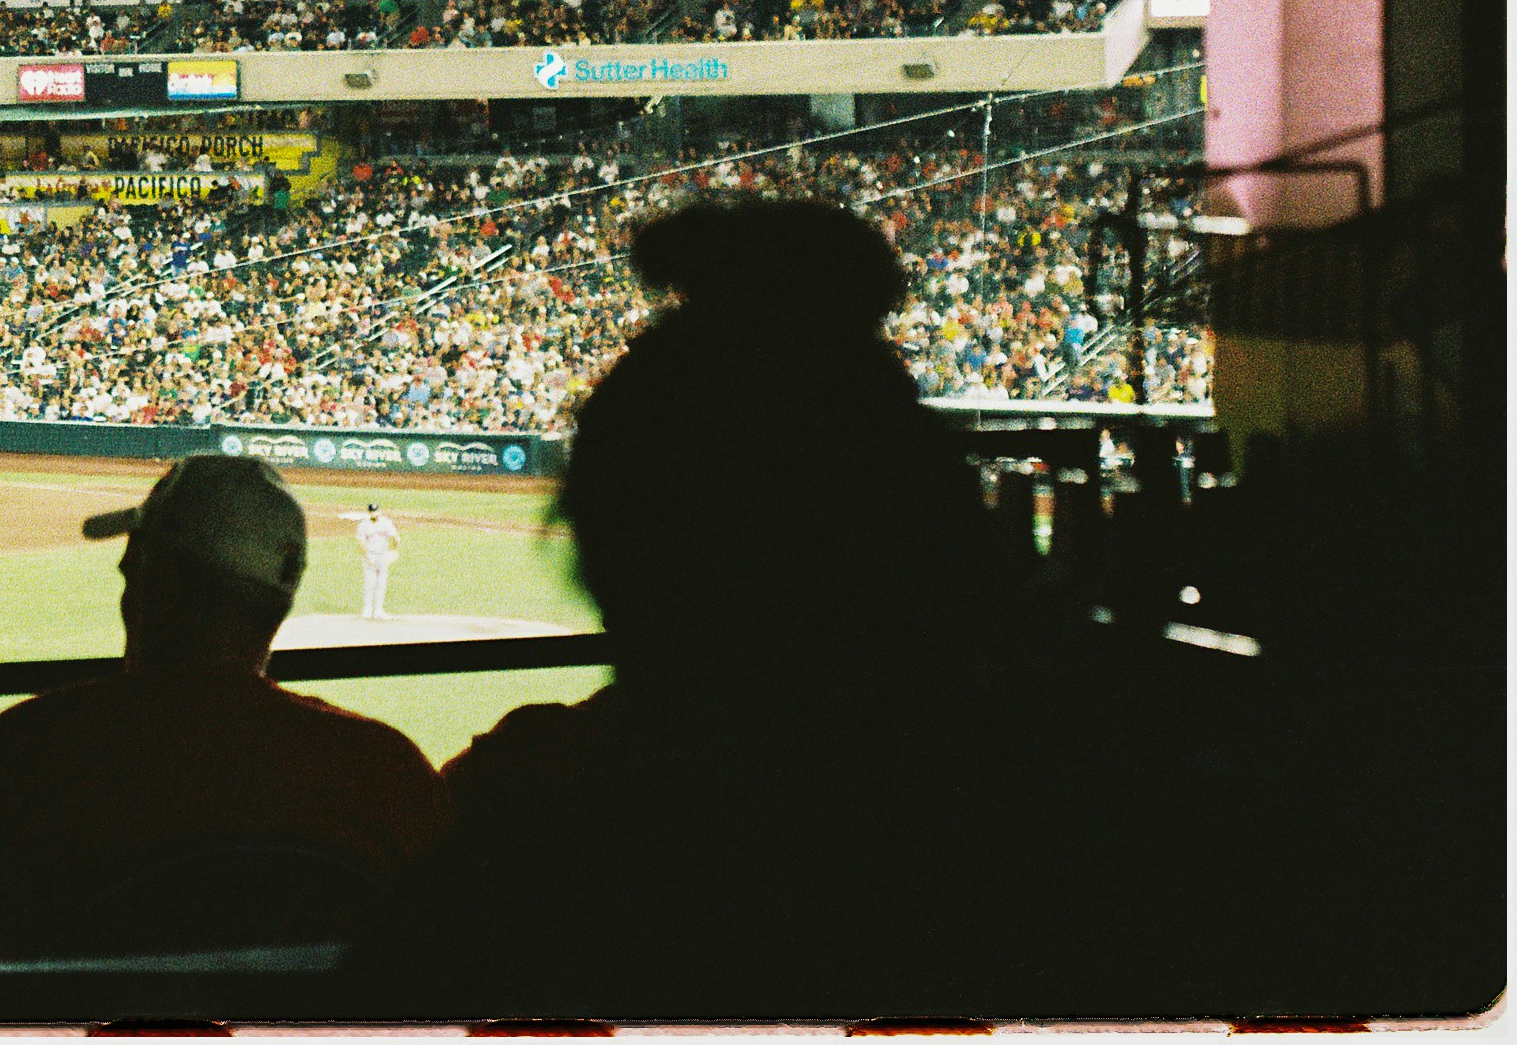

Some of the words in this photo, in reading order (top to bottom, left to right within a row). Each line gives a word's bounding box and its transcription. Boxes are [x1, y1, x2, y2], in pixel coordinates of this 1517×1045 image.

[574, 58, 647, 82] Sutter
[650, 57, 729, 81] Health
[114, 176, 201, 199] PACIFICO
